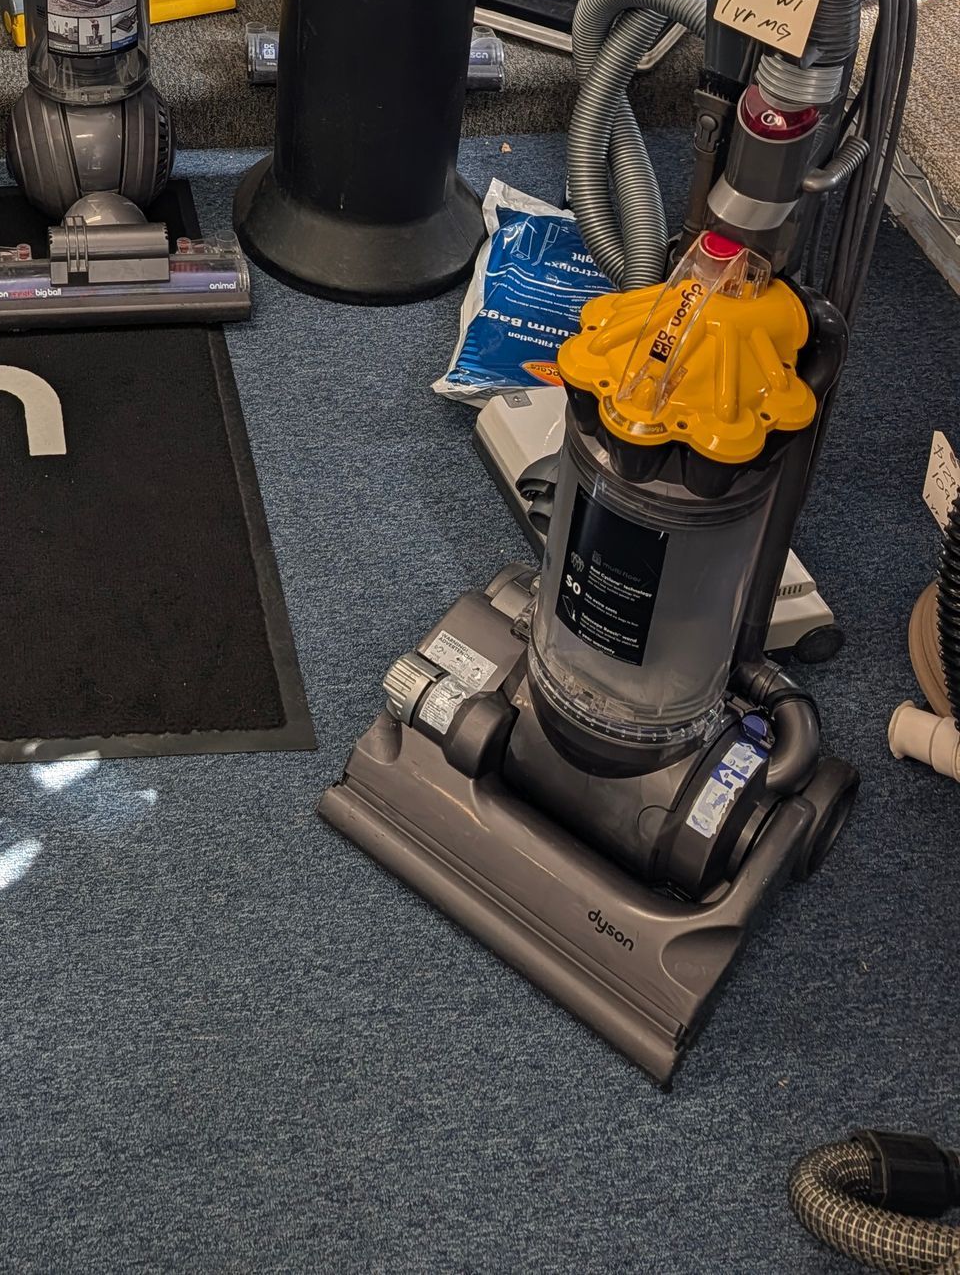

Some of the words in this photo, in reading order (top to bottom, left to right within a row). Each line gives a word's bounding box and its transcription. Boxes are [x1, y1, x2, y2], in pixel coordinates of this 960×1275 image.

[735, 6, 756, 24] yr
[761, 19, 792, 41] MG
[209, 281, 237, 290] animal
[671, 283, 703, 327] dyson
[479, 308, 525, 330] Bags
[508, 331, 554, 349] Filtration
[657, 330, 677, 346] DC
[652, 342, 671, 356] 33
[441, 633, 468, 652] WARNING!
[587, 909, 635, 952] dyson
